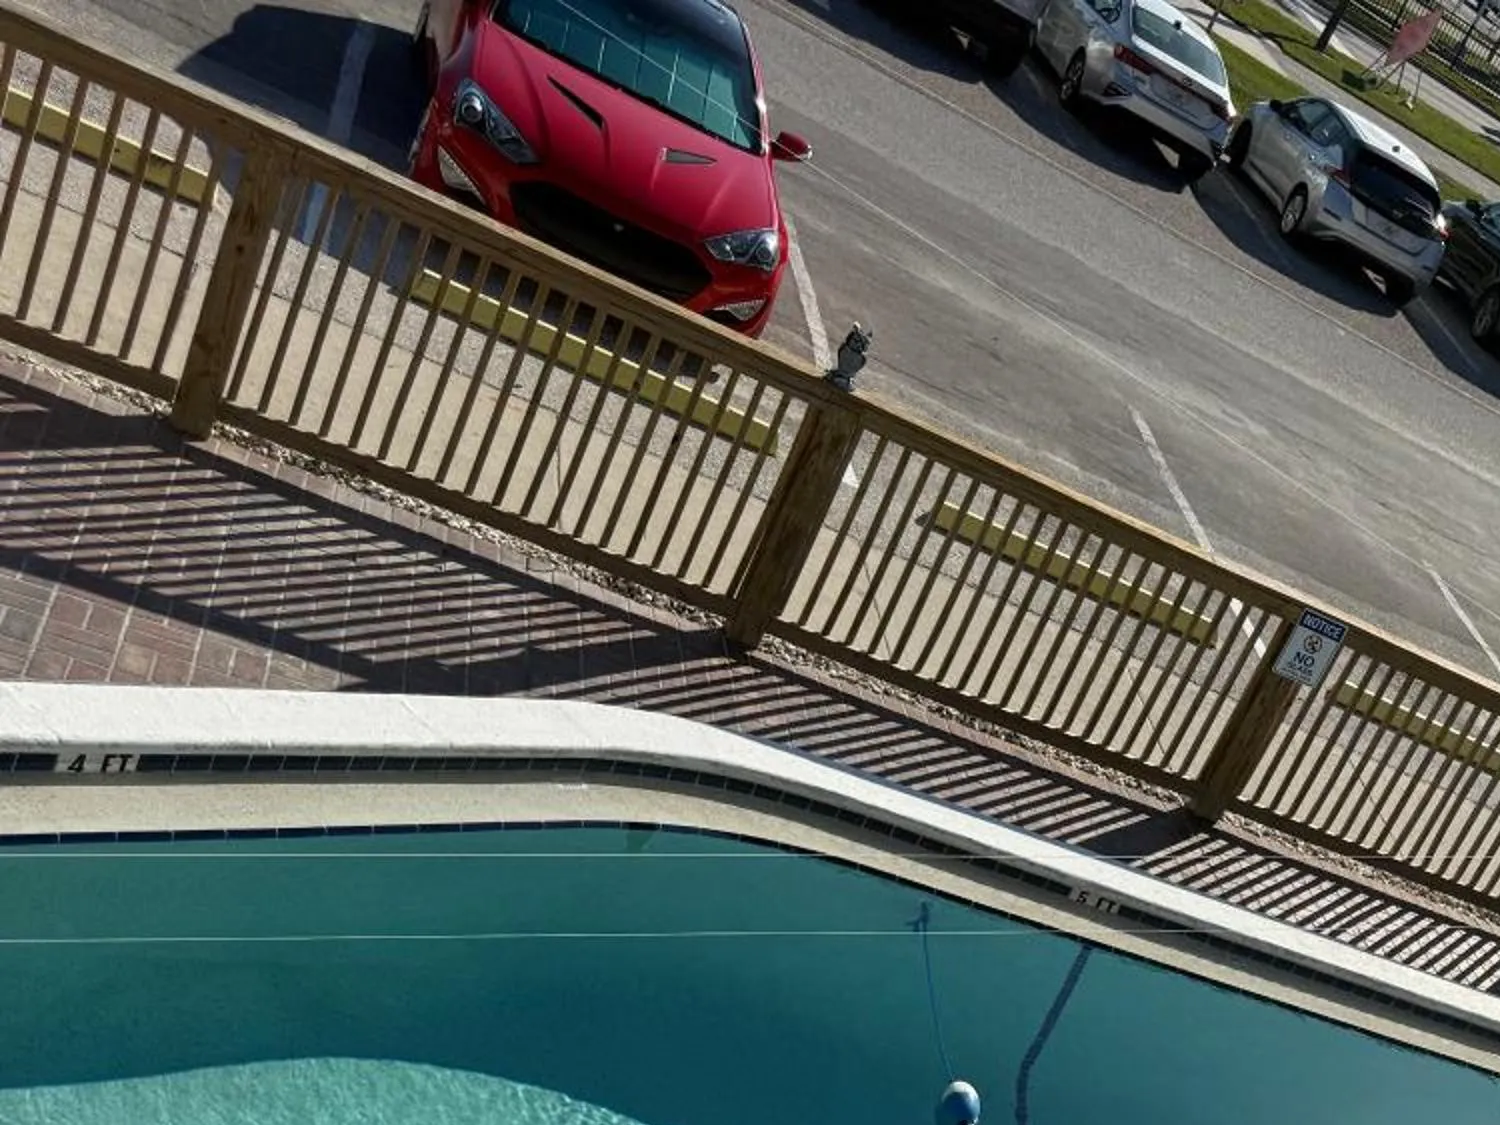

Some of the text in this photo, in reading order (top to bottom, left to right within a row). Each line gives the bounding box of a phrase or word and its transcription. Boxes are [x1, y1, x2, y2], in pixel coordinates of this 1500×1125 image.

[1303, 614, 1344, 639] NOTICE
[1293, 652, 1315, 668] NO
[67, 754, 133, 773] 4 FT
[1075, 891, 1118, 913] 5 FT
